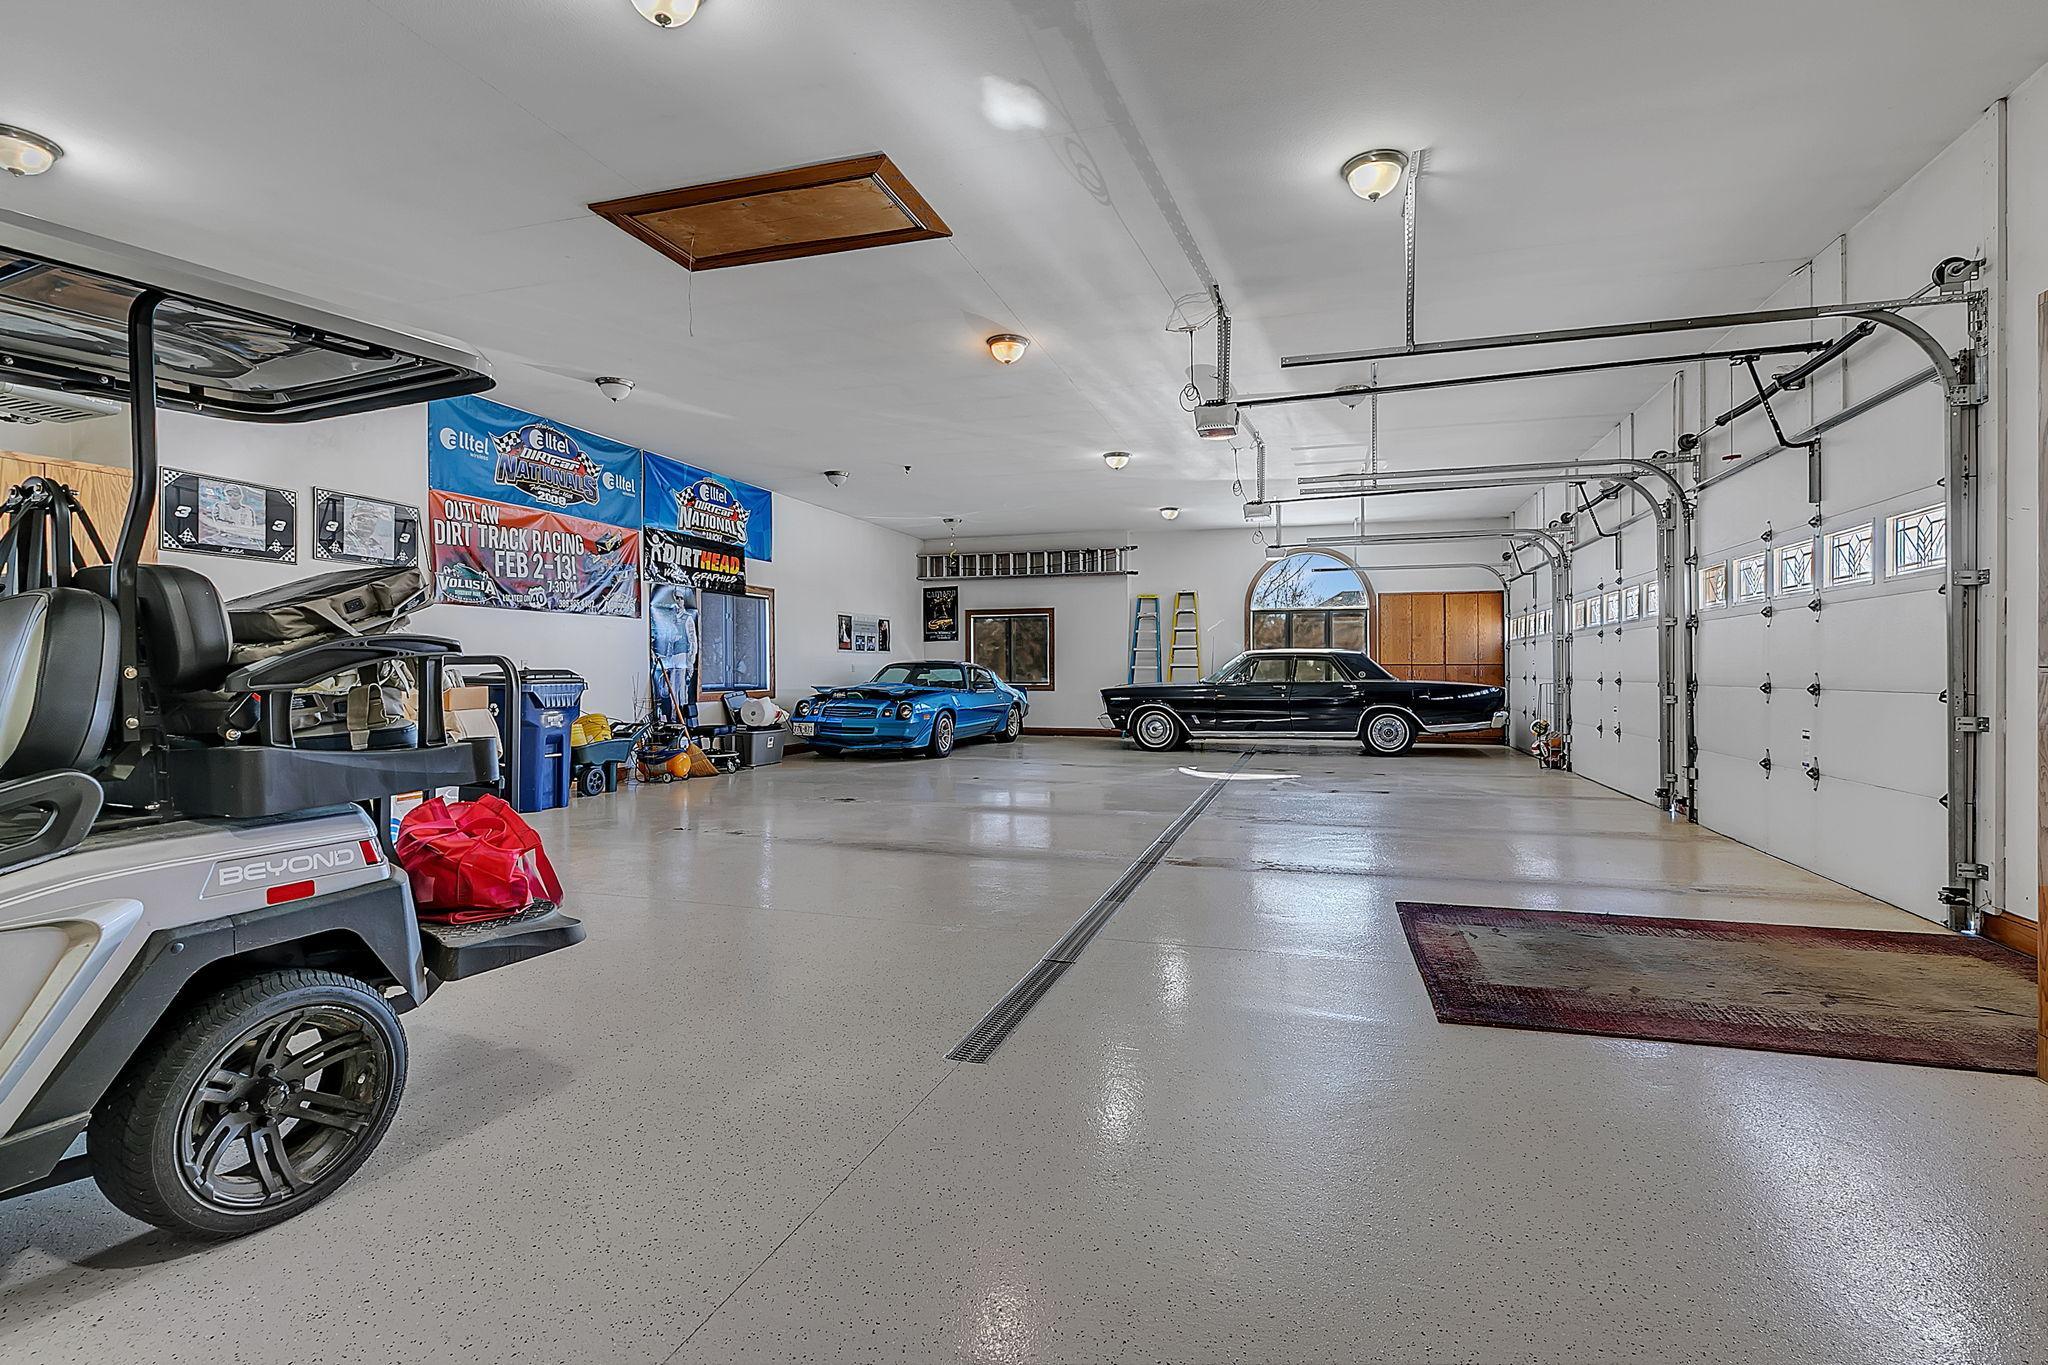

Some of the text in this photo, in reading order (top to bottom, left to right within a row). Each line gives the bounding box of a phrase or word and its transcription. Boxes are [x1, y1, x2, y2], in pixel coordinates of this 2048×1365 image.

[174, 505, 192, 518] 3
[444, 500, 500, 525] OUTLAW
[272, 520, 287, 532] 3
[325, 521, 339, 532] 3
[433, 519, 585, 555] DIRT TRACK RACING
[679, 506, 747, 543] NATIONALS
[399, 533, 411, 543] 3
[494, 550, 577, 581] FEB 2-13!
[662, 543, 740, 575] DIRTHEAD
[439, 575, 497, 596] VOLUSIA
[219, 849, 355, 885] BEYOND
